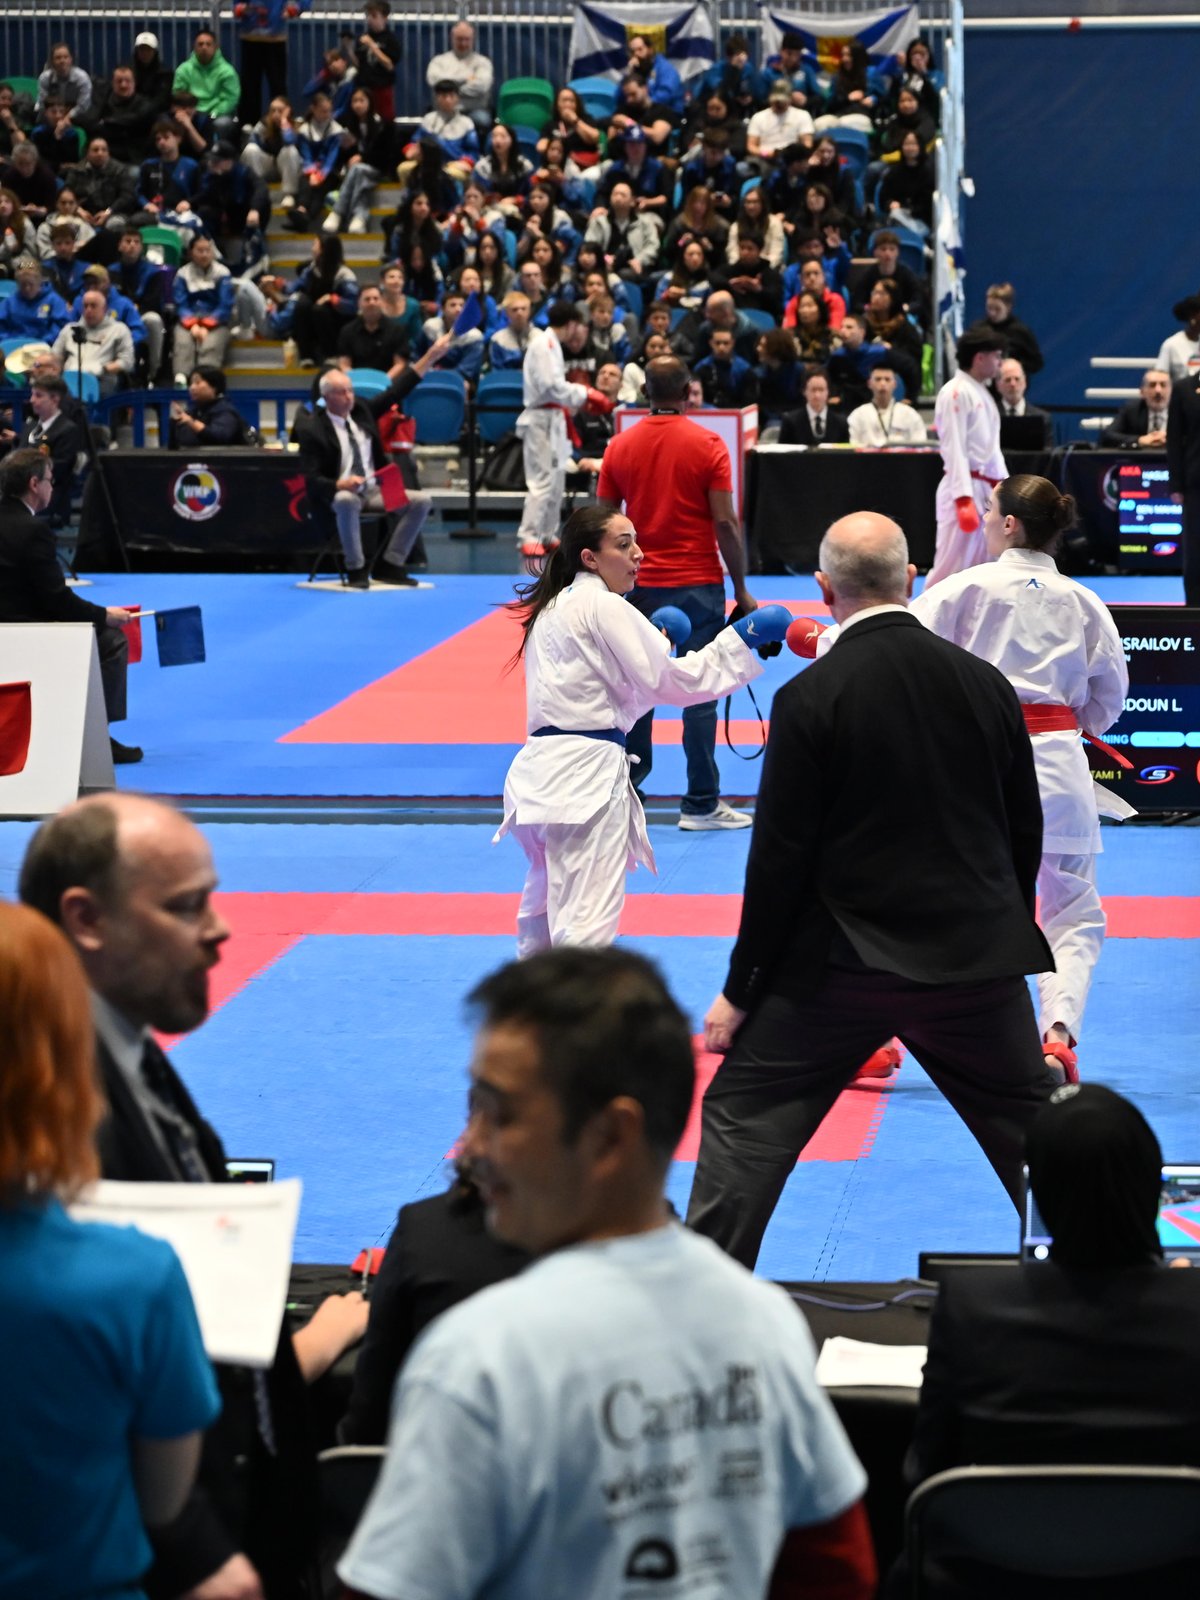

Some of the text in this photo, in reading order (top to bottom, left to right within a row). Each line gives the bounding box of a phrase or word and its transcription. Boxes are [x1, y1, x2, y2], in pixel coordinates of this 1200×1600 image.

[1183, 637, 1196, 651] E.
[1171, 698, 1183, 712] L.
[1116, 770, 1122, 780] 1
